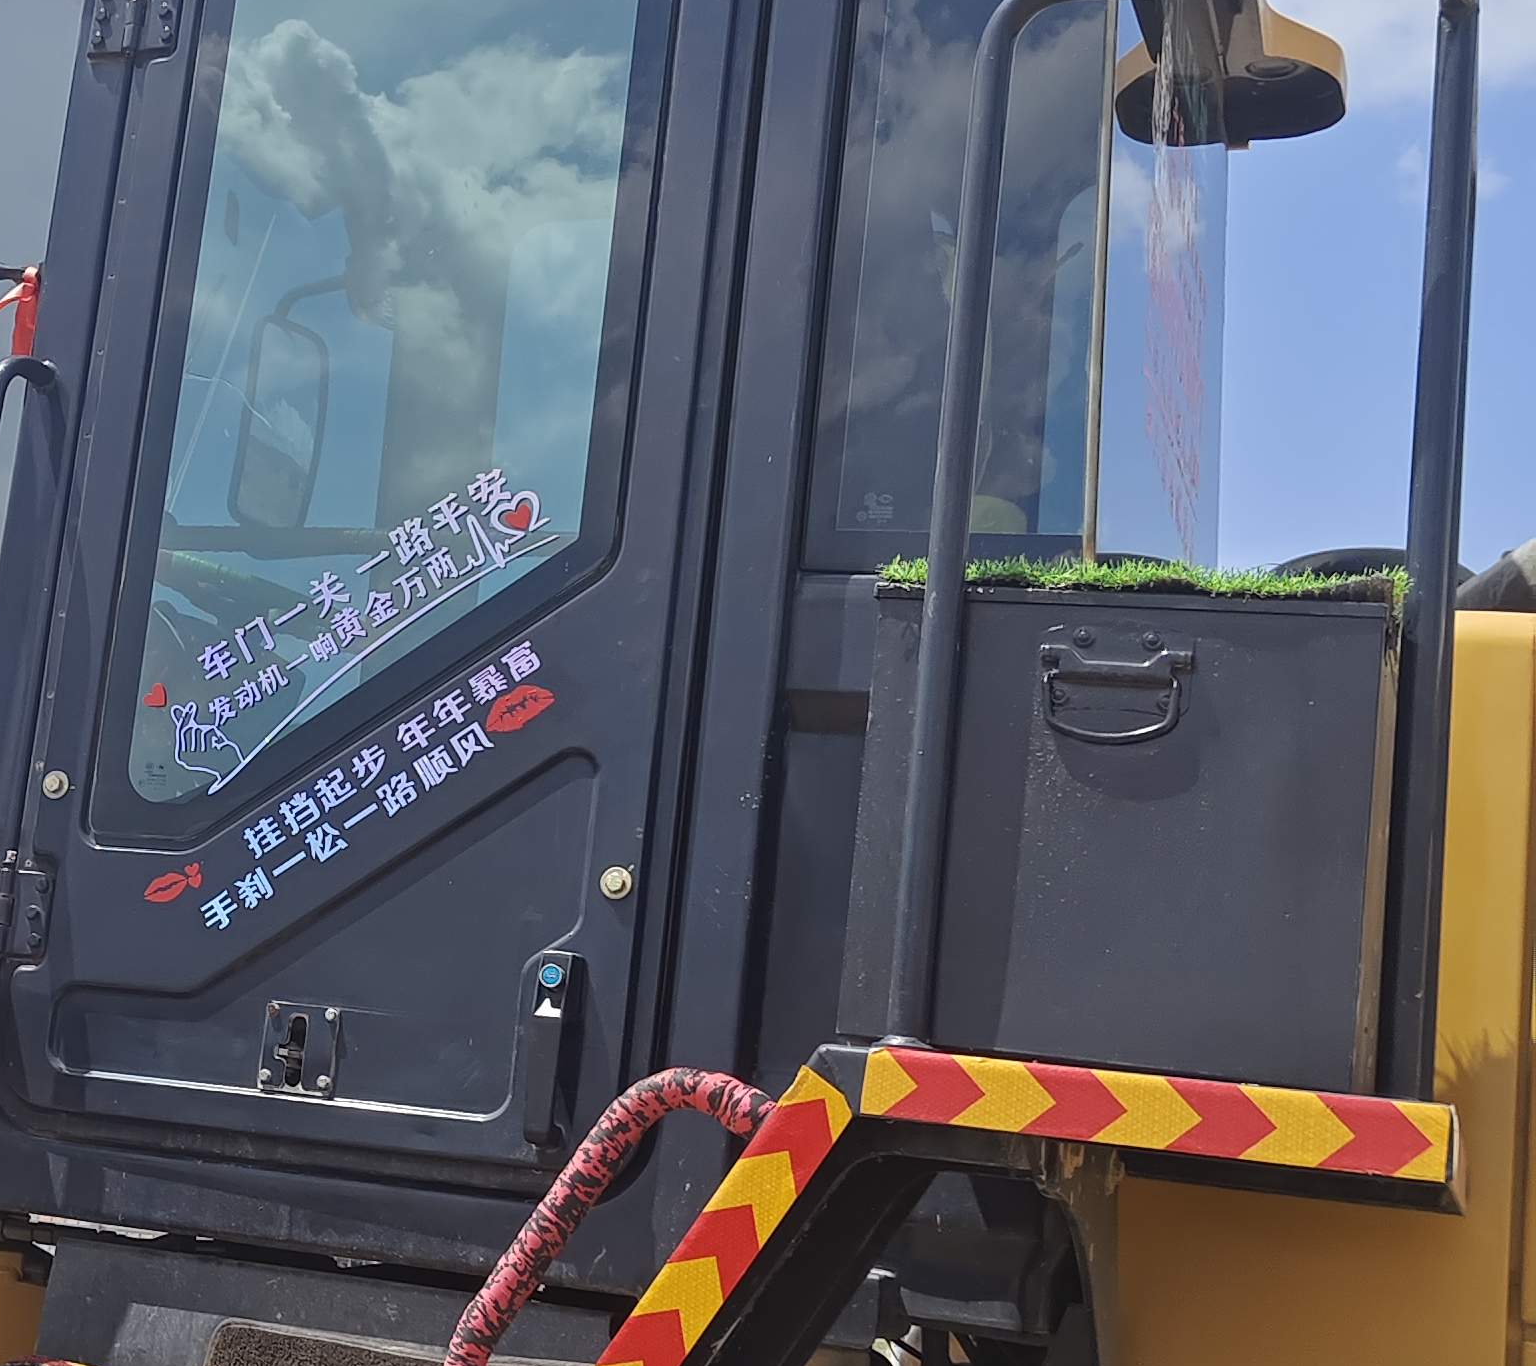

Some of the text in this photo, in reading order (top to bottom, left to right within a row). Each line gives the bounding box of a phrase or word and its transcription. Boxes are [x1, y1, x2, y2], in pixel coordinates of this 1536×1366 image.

[197, 468, 513, 682] 车门一关 一路平安
[208, 546, 459, 727] 发动机一响黄金万两
[199, 722, 495, 931] 手刹一松一路顺风
[243, 640, 542, 860] 挂挡起步 年年暴富
